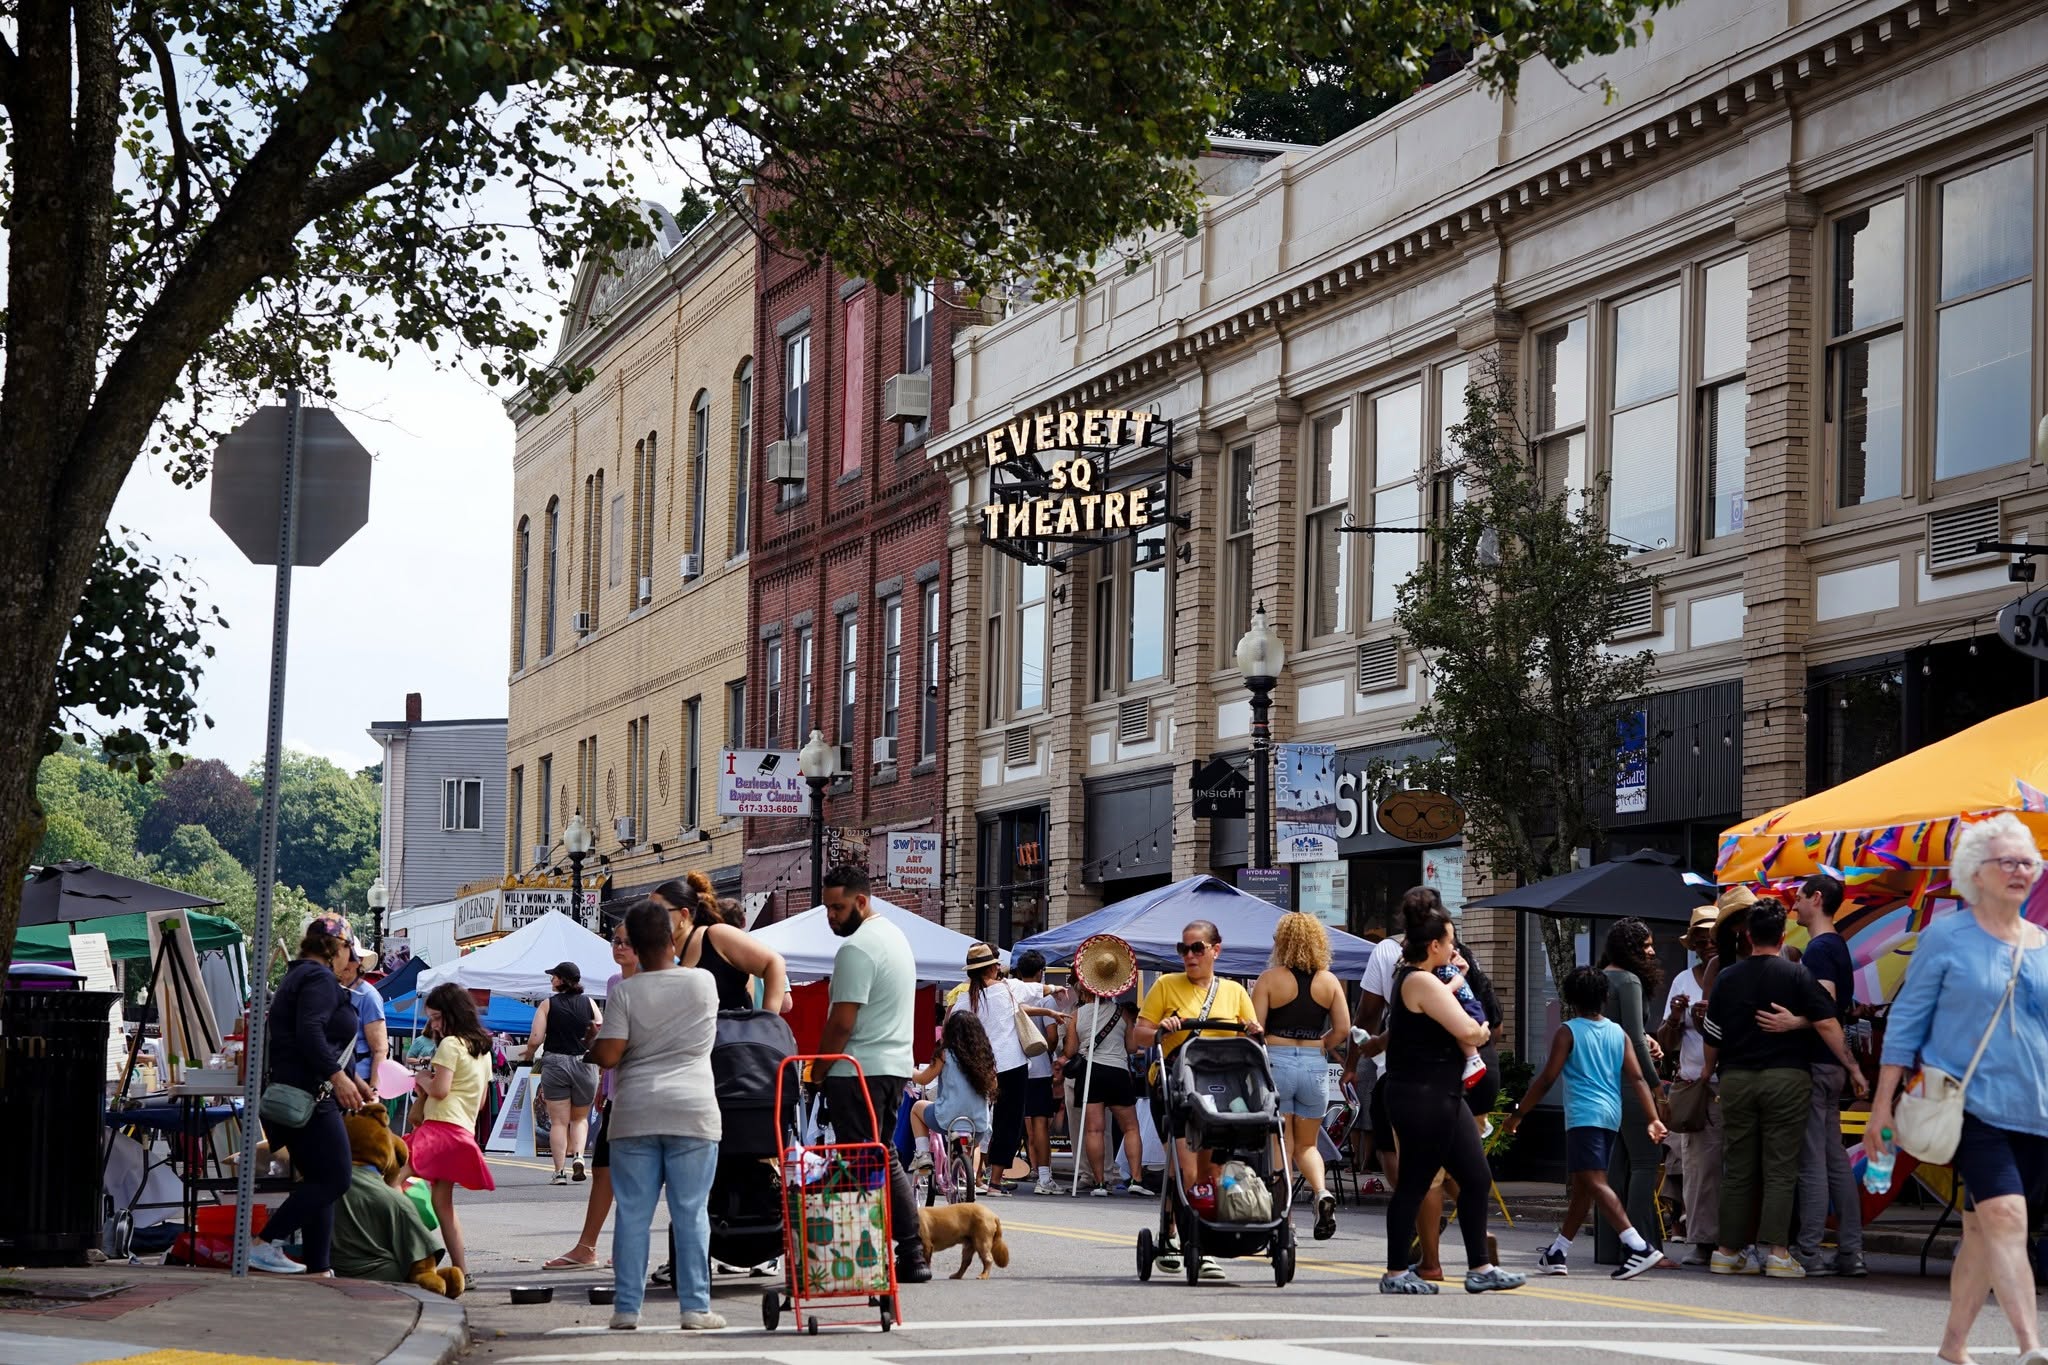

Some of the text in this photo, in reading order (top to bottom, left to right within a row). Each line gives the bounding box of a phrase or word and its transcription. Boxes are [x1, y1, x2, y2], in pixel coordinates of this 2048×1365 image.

[986, 409, 1153, 466] EVERETT
[1051, 457, 1092, 492] SQ
[984, 487, 1149, 540] THEATRE
[1297, 745, 1329, 755] 02136
[1277, 745, 1290, 802] Explore
[787, 778, 801, 790] H.
[766, 790, 803, 803] Church
[1196, 789, 1244, 799] INSIGHT
[738, 804, 798, 814] 617-333-6805
[847, 829, 870, 837] 02136
[893, 838, 936, 851] SWITCH
[905, 855, 923, 864] ART
[1018, 842, 1039, 866] ART
[895, 865, 933, 875] FASHION
[900, 876, 928, 886] MUSIC
[504, 892, 525, 903] WILLY
[526, 893, 551, 904] WONKA
[586, 894, 596, 904] 23
[458, 896, 495, 927] RIVERSIDE
[504, 904, 517, 915] THE
[519, 905, 549, 916] ADDAMS
